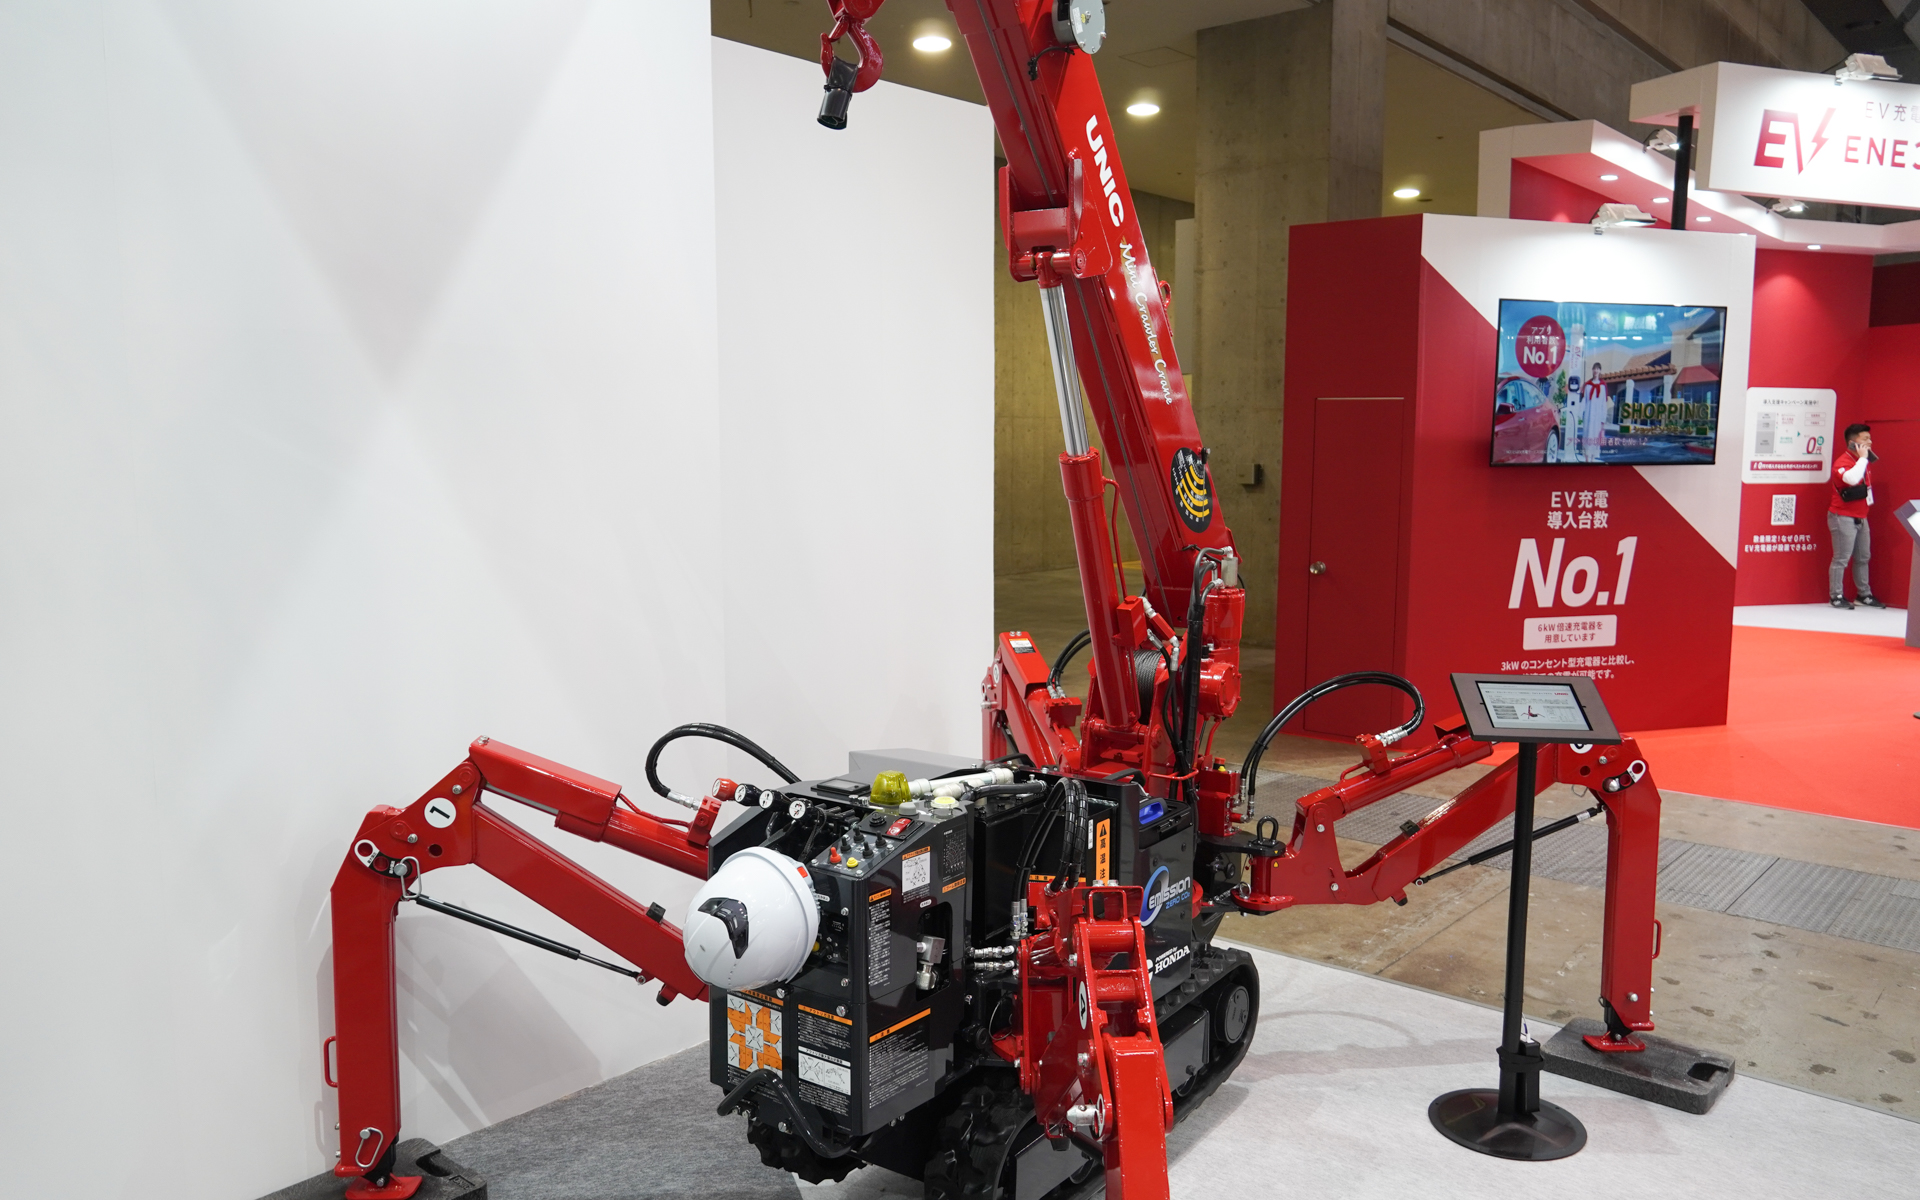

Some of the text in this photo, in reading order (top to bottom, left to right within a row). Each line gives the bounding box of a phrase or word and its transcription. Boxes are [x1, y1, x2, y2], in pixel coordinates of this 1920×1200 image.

[1085, 114, 1173, 406] UNIC Mini Crawler Crane
[1523, 346, 1558, 365] No.1
[1620, 402, 1711, 420] SHOPPING
[1550, 490, 1609, 509] EV充電
[1547, 510, 1608, 530] 導入台数
[1508, 536, 1638, 609] No.1
[1544, 633, 1596, 643] 用意しています
[429, 805, 451, 819] 1
[1165, 895, 1180, 910] ZERO
[1154, 944, 1191, 975] HONDA
